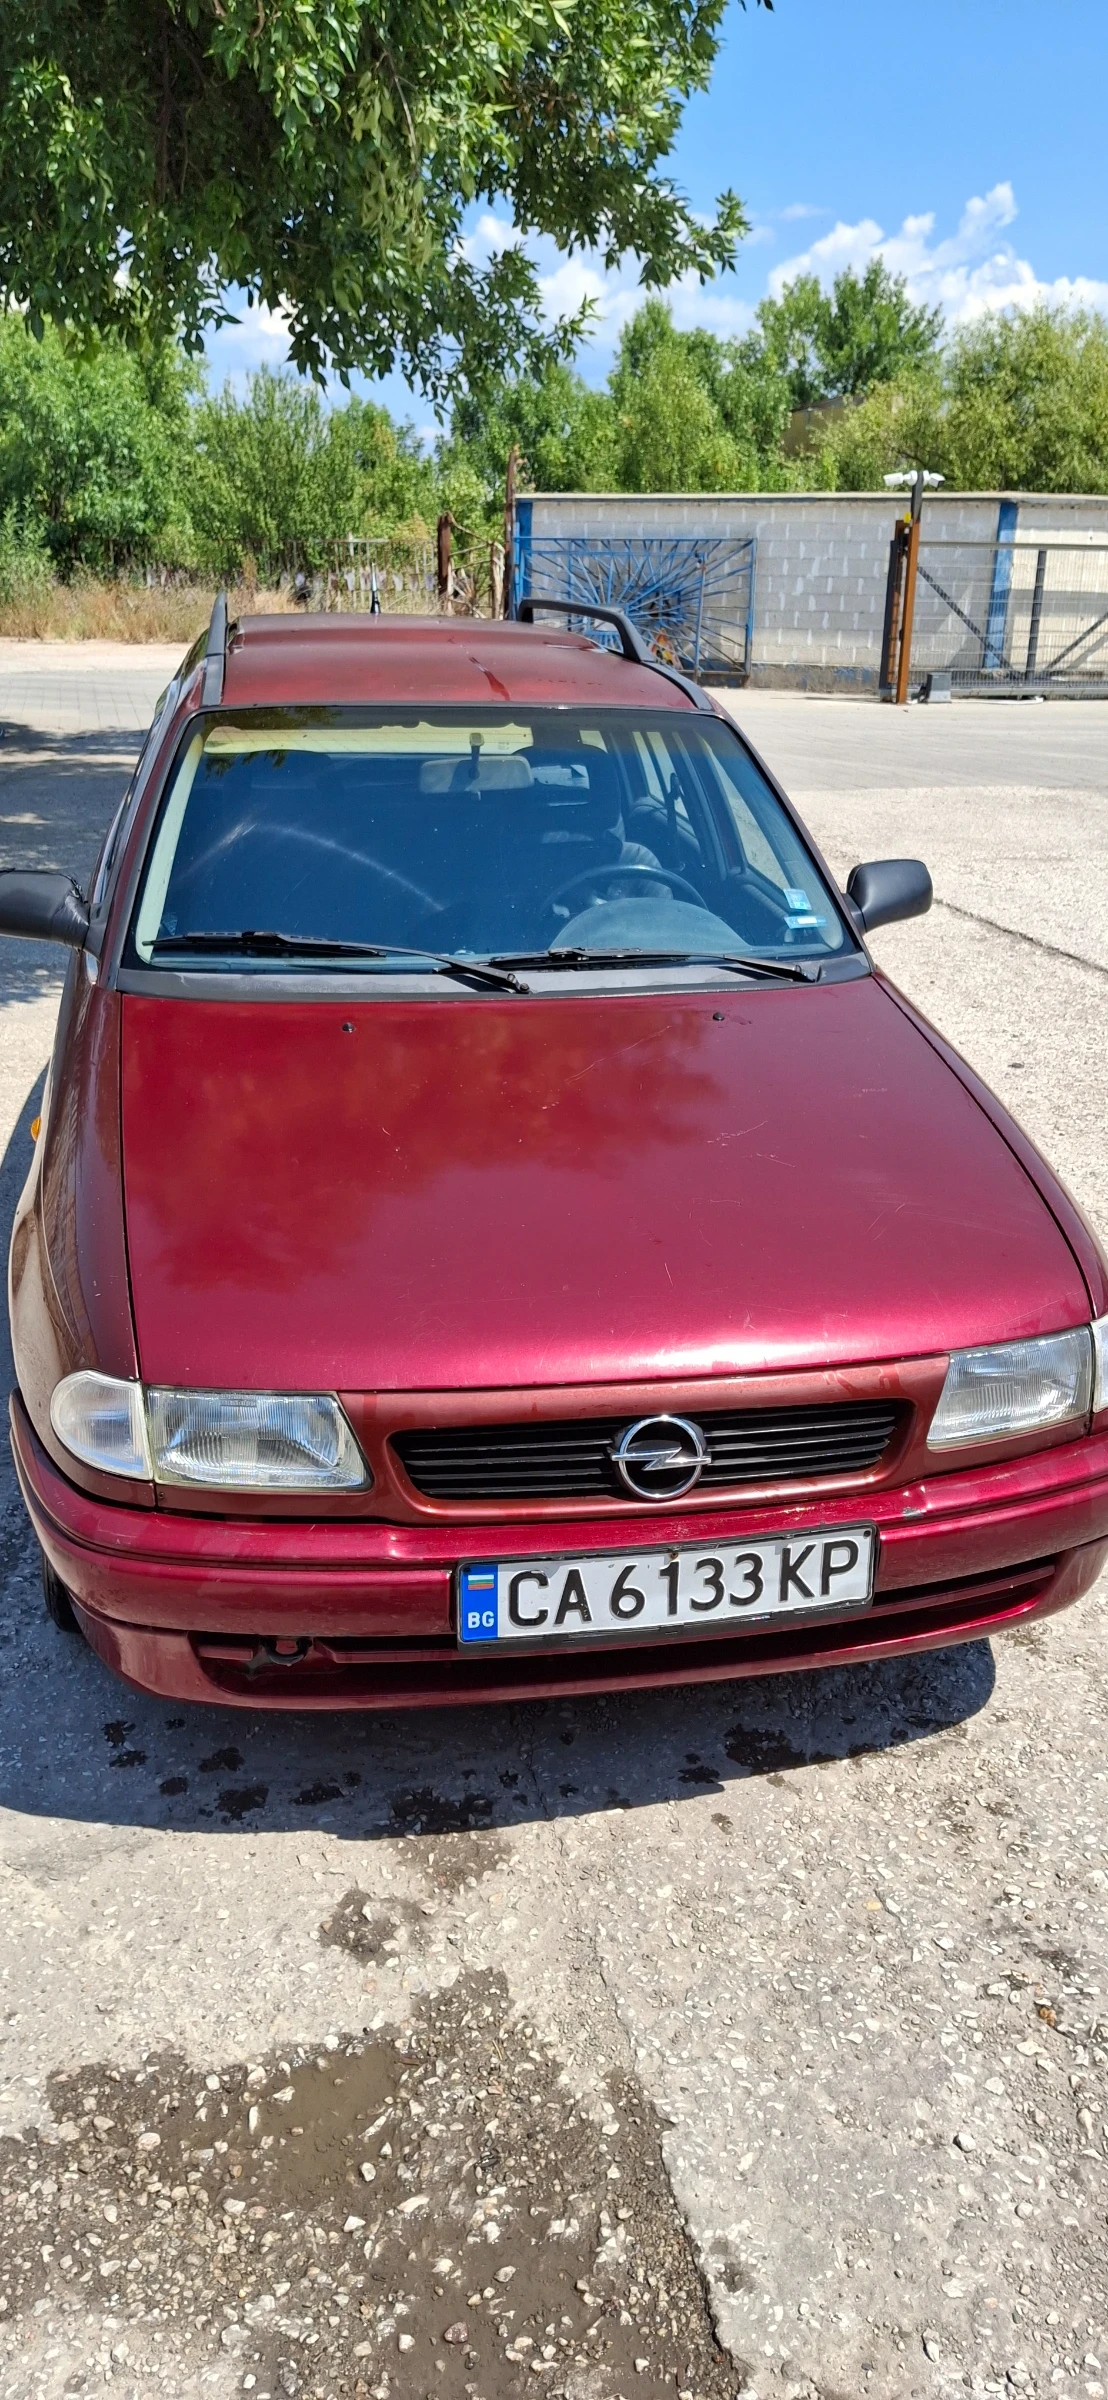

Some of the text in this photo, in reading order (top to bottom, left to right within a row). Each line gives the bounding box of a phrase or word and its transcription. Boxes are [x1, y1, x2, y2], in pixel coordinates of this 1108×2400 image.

[508, 1538, 859, 1627] CA 6133 KP
[467, 1610, 495, 1629] BG
